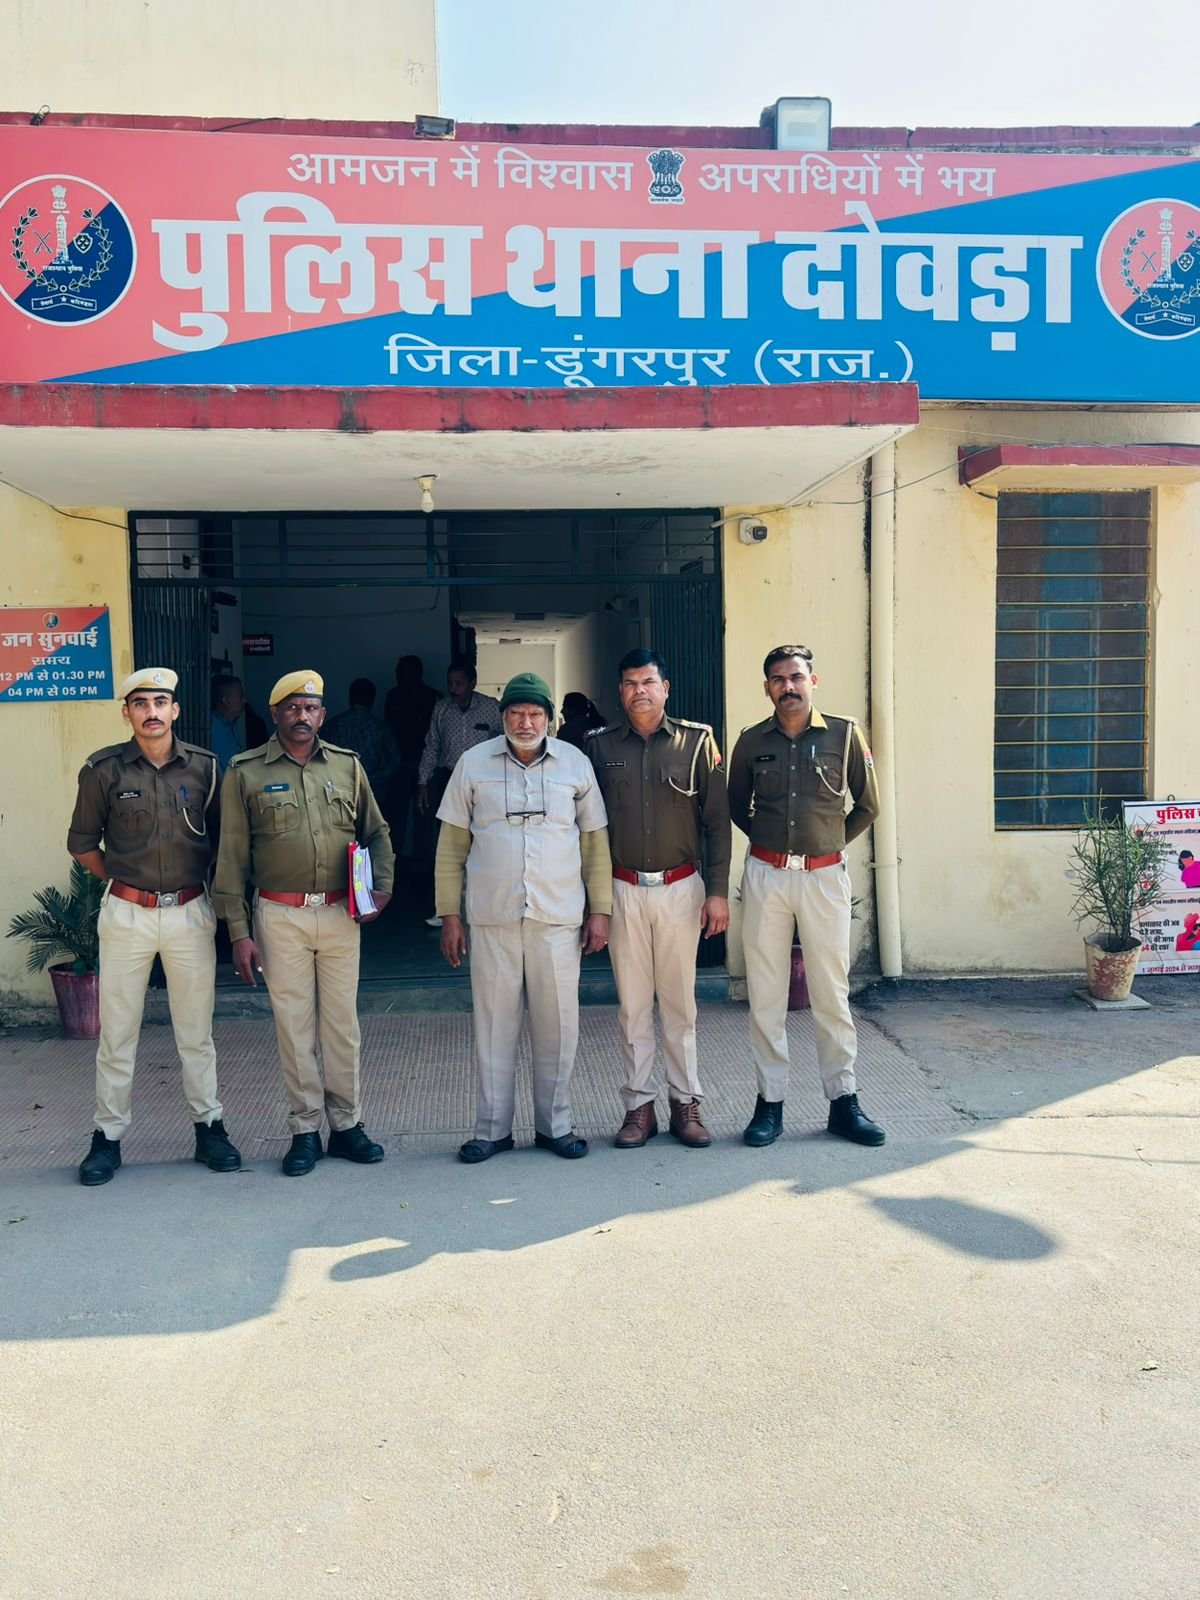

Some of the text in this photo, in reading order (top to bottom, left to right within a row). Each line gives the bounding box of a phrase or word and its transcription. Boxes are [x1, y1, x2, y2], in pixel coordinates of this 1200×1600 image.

[287, 145, 996, 197] आमजन में विश्वास अपराधियों में भय
[151, 191, 1083, 352] पुलिस थाना दोवड़ा
[754, 340, 914, 385] (राज.)
[1, 626, 98, 652] जन सुनवाई
[31, 655, 71, 665] समय
[16, 671, 33, 681] PM
[37, 669, 48, 681] से
[52, 671, 84, 680] 01.30
[88, 670, 105, 679] PM
[8, 684, 97, 697] 04 PM से 05 PM
[1156, 806, 1195, 824] पुलिस
